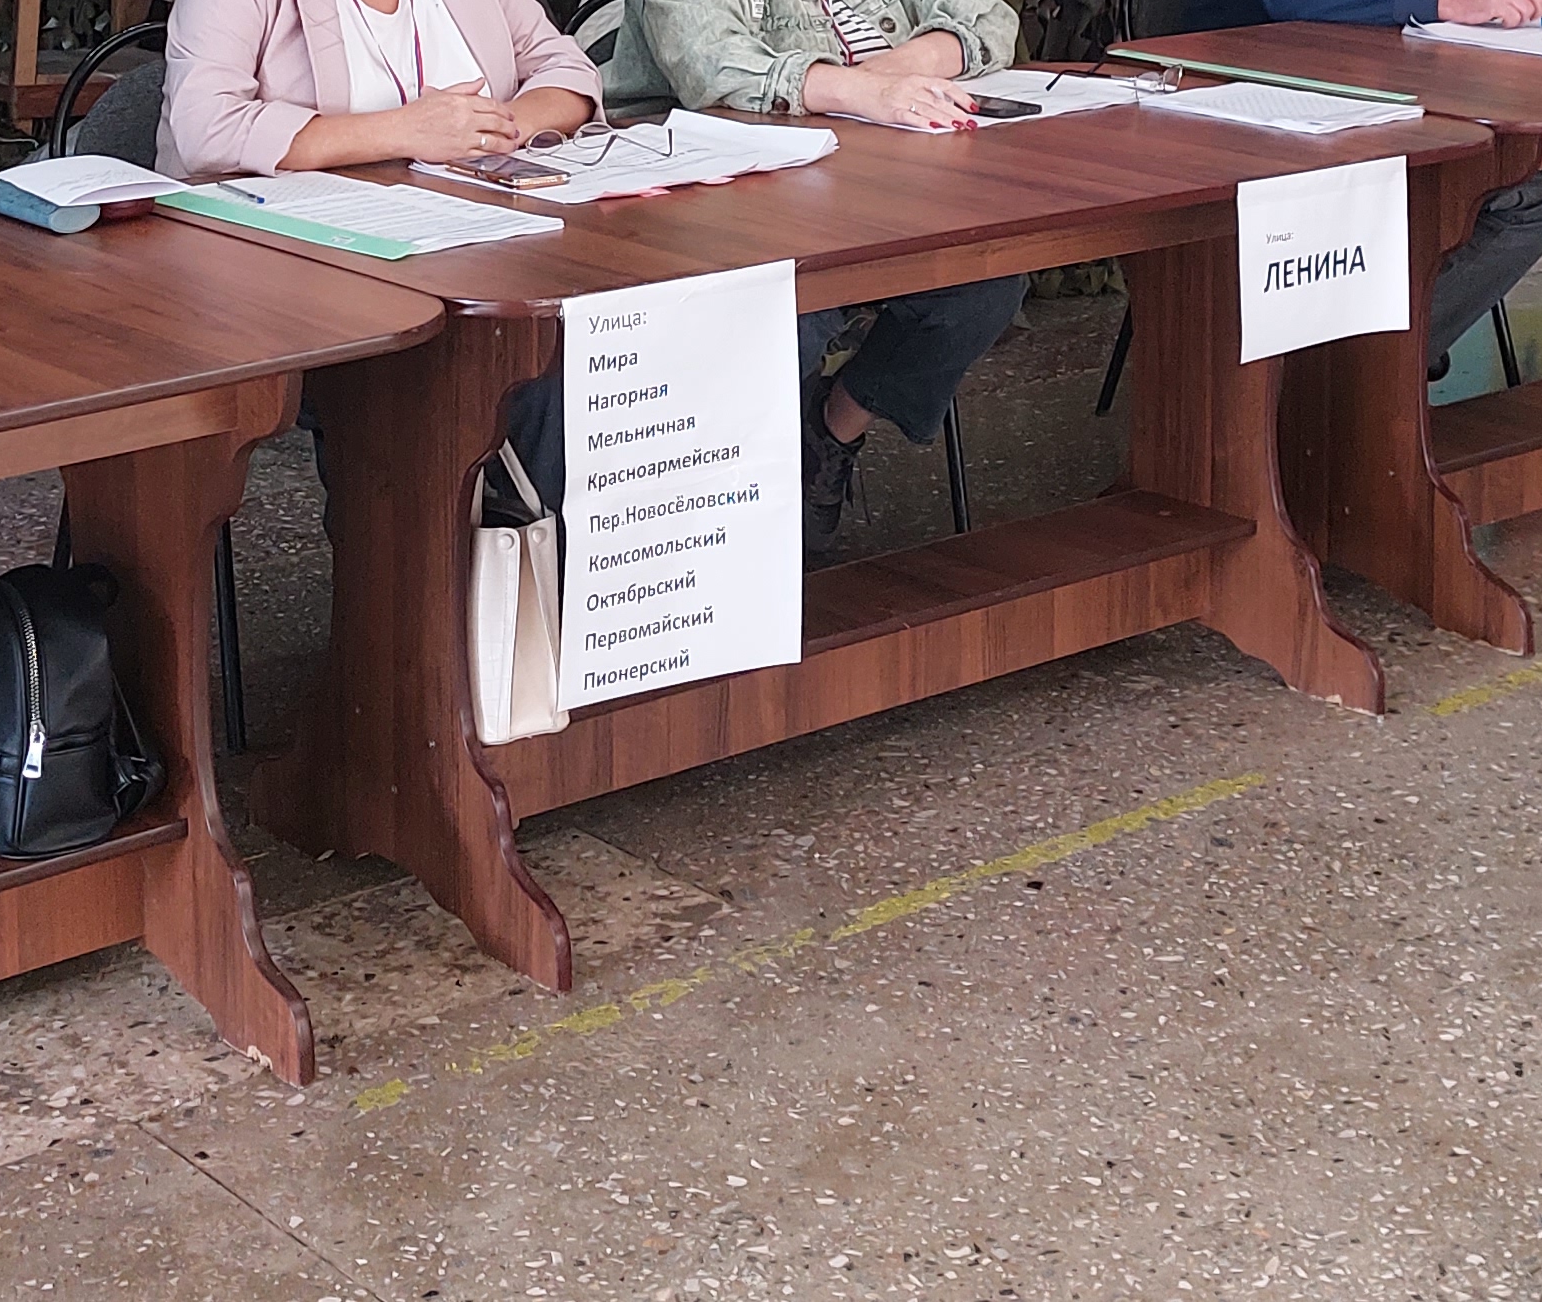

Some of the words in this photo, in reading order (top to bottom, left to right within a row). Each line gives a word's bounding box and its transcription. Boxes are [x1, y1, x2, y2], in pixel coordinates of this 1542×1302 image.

[1266, 230, 1295, 245] Улица:
[1263, 245, 1366, 294] ЛЕНИНА
[588, 310, 648, 336] Улица:
[588, 351, 639, 374] Мира
[587, 382, 669, 413] Нагорная
[587, 415, 697, 453] Мельничная
[587, 443, 741, 492] Красноармейская
[589, 483, 761, 535] Пер.Новосёловский
[588, 526, 727, 573] Комсомольский
[586, 570, 697, 613] Октябрьский
[584, 606, 715, 653] Первомайский
[583, 649, 691, 692] Пионерский
